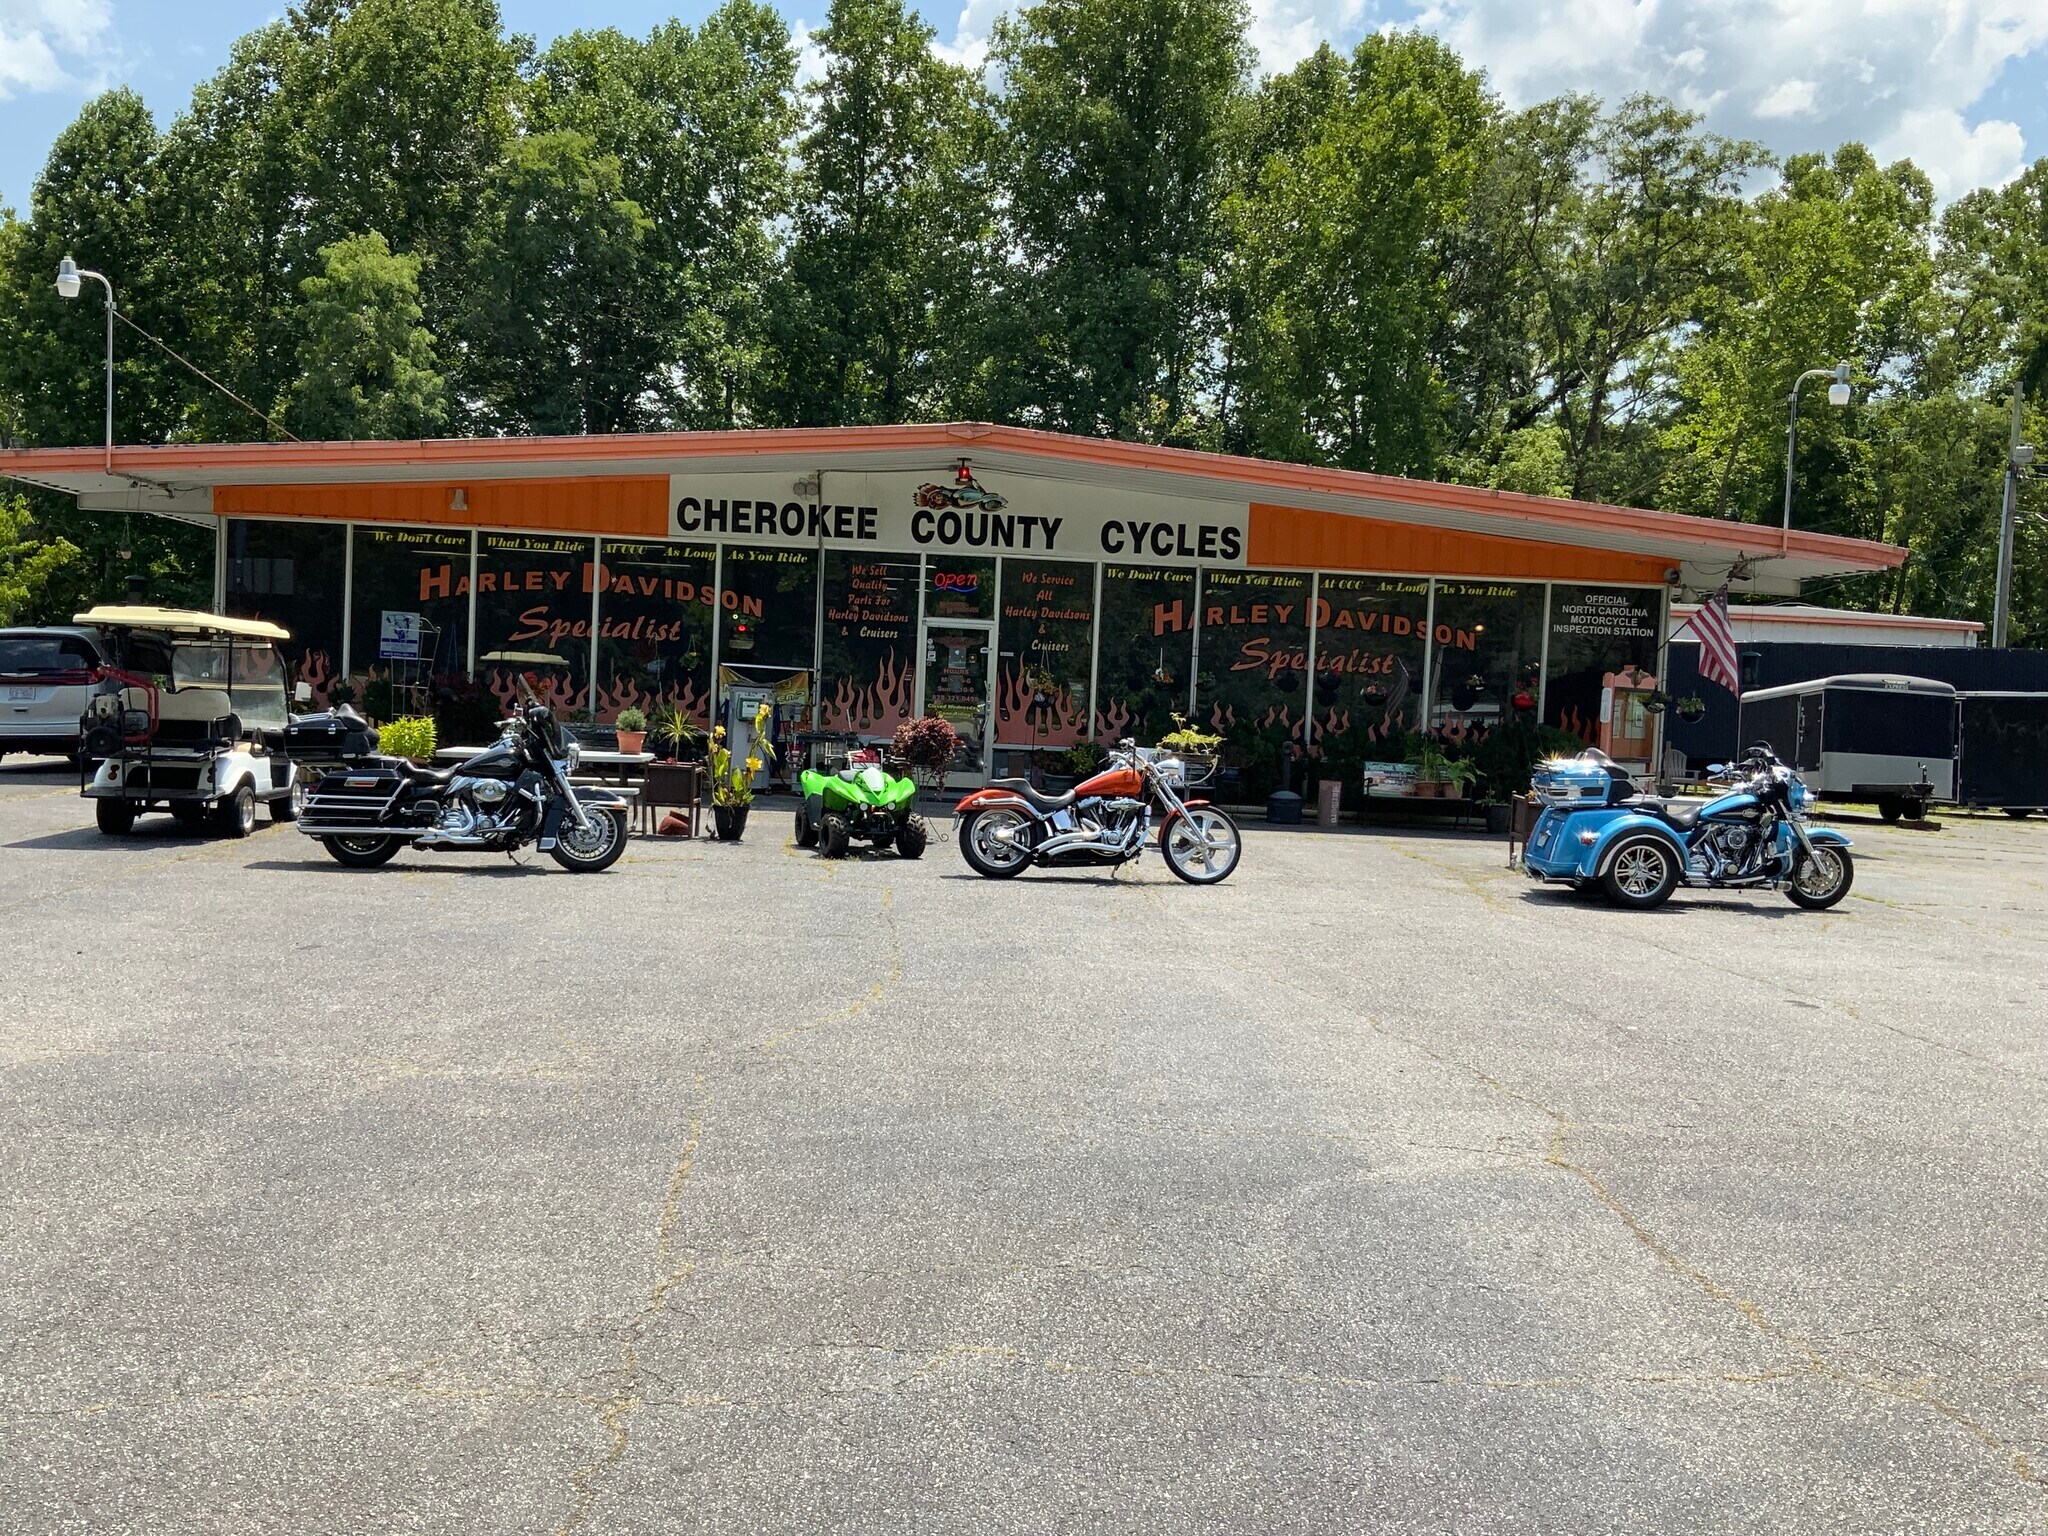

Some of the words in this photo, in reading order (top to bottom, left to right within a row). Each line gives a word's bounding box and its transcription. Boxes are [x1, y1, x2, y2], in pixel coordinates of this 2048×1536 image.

[677, 497, 878, 540] CHEROKEE
[911, 510, 1063, 550] COUNTY
[1100, 520, 1241, 560] CYCLES
[374, 531, 393, 542] We
[397, 532, 432, 544] Don't
[435, 534, 466, 546] Care
[487, 537, 519, 549] What
[523, 539, 549, 551] You
[554, 540, 585, 552] Ride
[664, 546, 680, 557] As
[682, 547, 717, 562] Long
[728, 549, 744, 560] As
[749, 550, 773, 562] You
[777, 552, 808, 564] Ride
[852, 565, 867, 576] We
[869, 565, 888, 576] Sell
[1022, 572, 1037, 584] We
[1041, 573, 1074, 585] Service
[1107, 568, 1124, 579] We
[1128, 570, 1160, 581] Don't
[1163, 571, 1192, 582] Care
[1210, 573, 1240, 585] What
[1246, 575, 1268, 586] You
[1272, 576, 1303, 587] Ride
[1320, 578, 1335, 589] At
[1339, 580, 1363, 590] CCC
[1377, 581, 1392, 592] As
[1396, 582, 1428, 595] Long
[1439, 584, 1455, 594] As
[1459, 585, 1484, 596] You
[1487, 586, 1517, 597] Ride
[419, 564, 571, 601] HARLEY
[582, 562, 763, 618] DAVIDSON
[852, 579, 888, 592] Quality
[848, 594, 872, 606] Parts
[875, 594, 891, 606] For
[1036, 590, 1053, 601] All
[1585, 595, 1629, 605] OFFICIAL
[828, 609, 859, 622] Harley
[862, 610, 909, 623] Davidsons
[1005, 606, 1037, 619] Harley
[1041, 607, 1090, 620] Davidsons
[1562, 605, 1596, 615] NORTH
[1598, 607, 1648, 617] CAROLINA
[1305, 597, 1476, 651] DAVIDSON
[1571, 616, 1638, 626] MOTORCYCLE
[841, 627, 849, 636] &
[860, 626, 899, 639] Cruisers
[1039, 624, 1045, 633] &
[1553, 625, 1611, 636] INSPECTION
[1613, 627, 1654, 637] STATION
[1031, 639, 1069, 651] Cruisers
